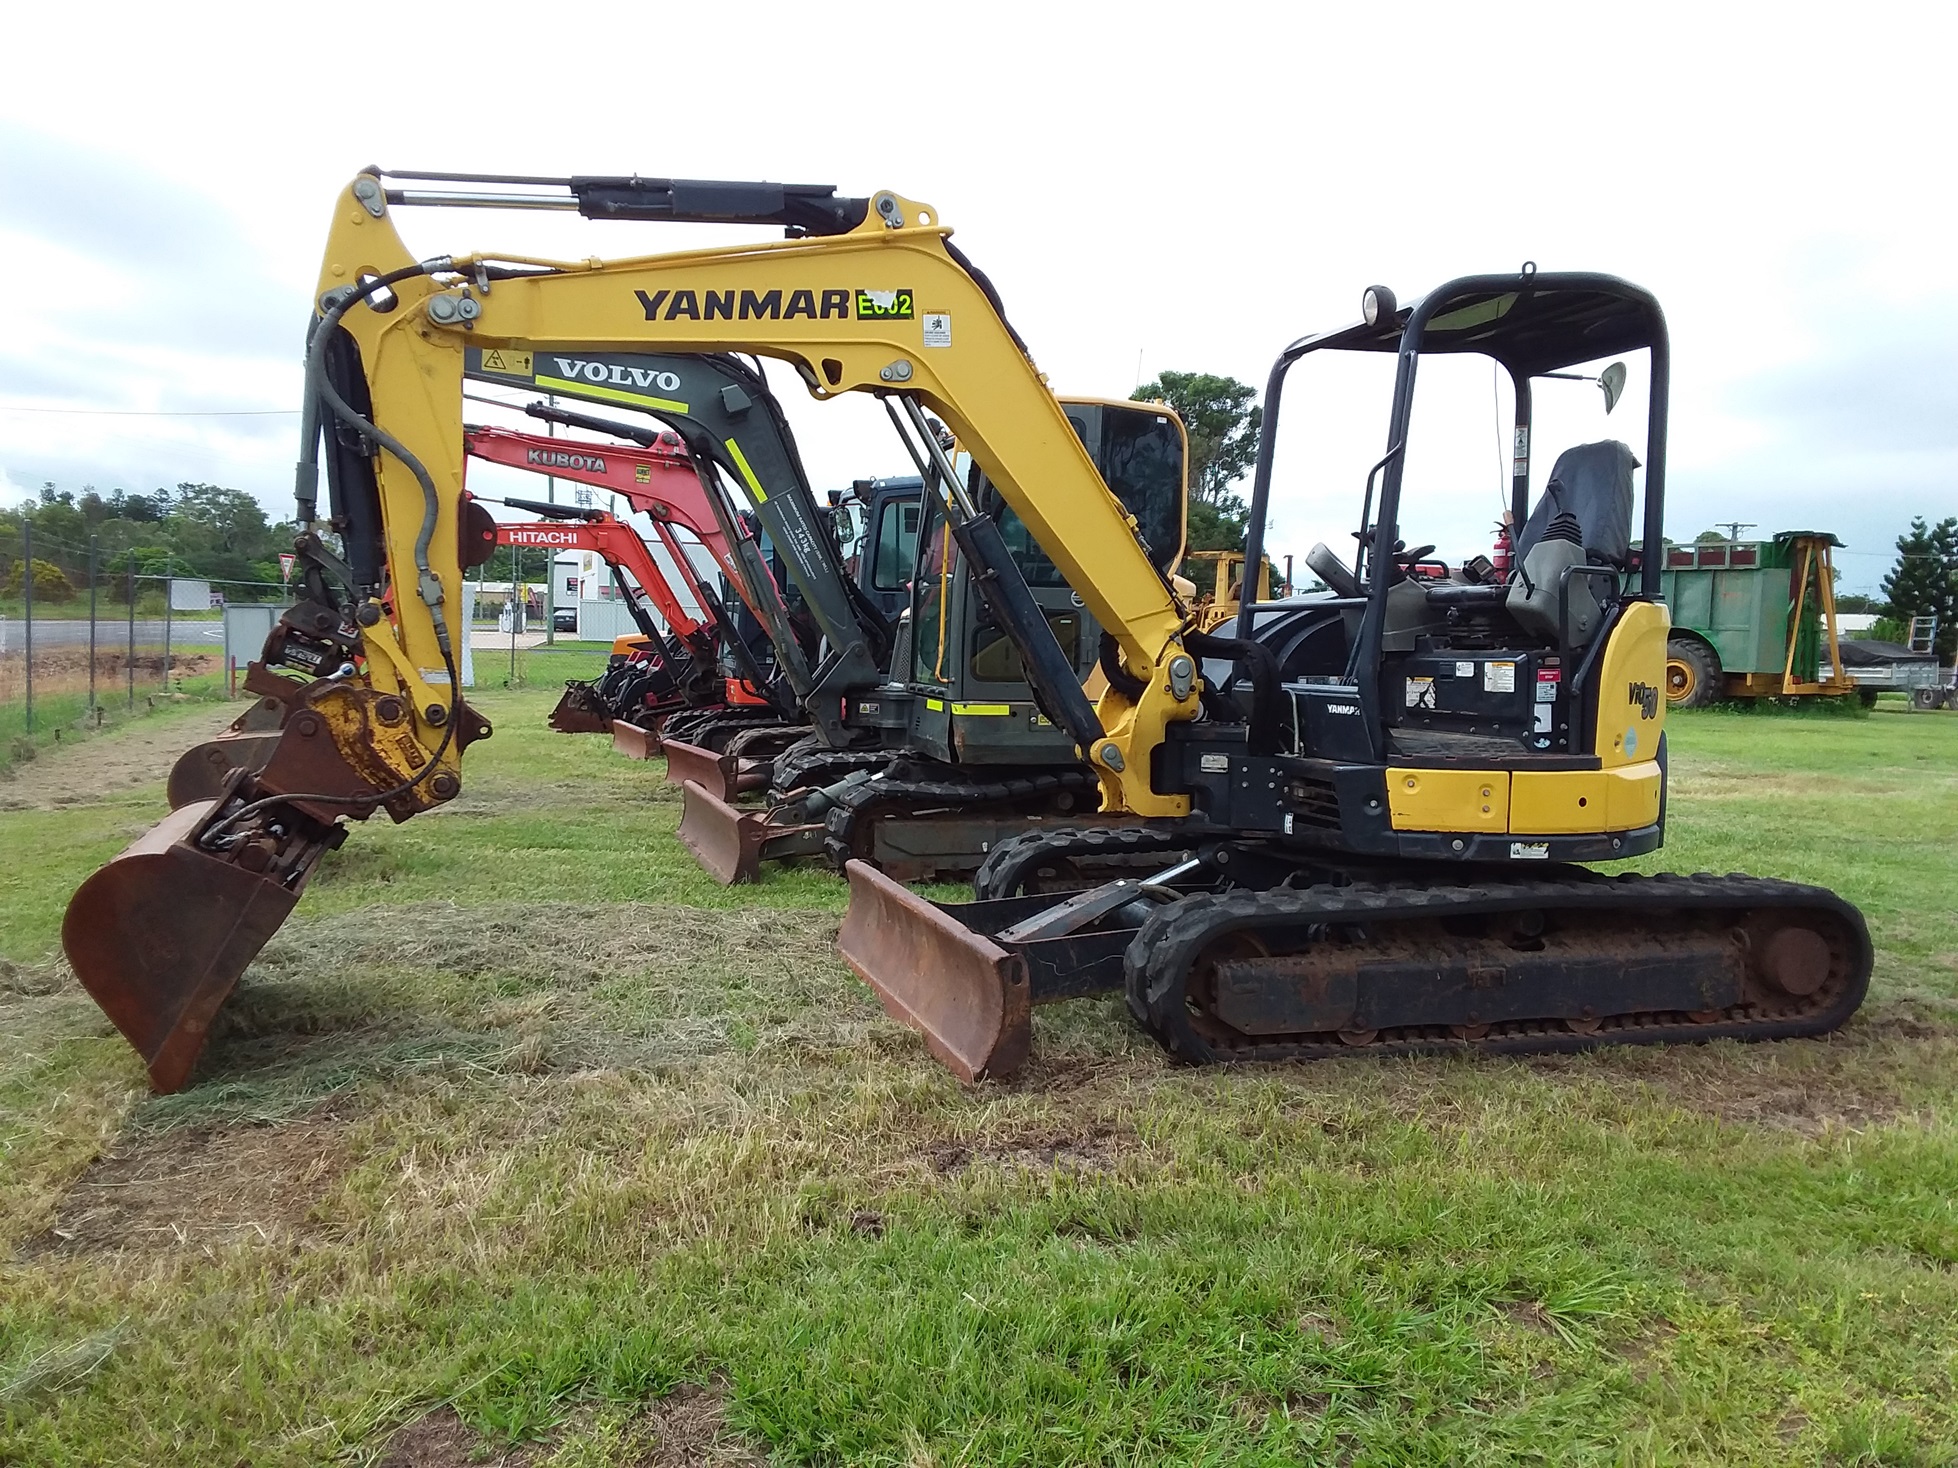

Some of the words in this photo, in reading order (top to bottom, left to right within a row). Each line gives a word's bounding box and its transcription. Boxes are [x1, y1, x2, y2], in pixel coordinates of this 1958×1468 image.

[634, 290, 849, 320] YANMAR
[553, 357, 681, 391] VOLVO
[527, 449, 607, 473] KUBOTA
[509, 531, 578, 544] HITACHI
[795, 527, 811, 554] 343kg
